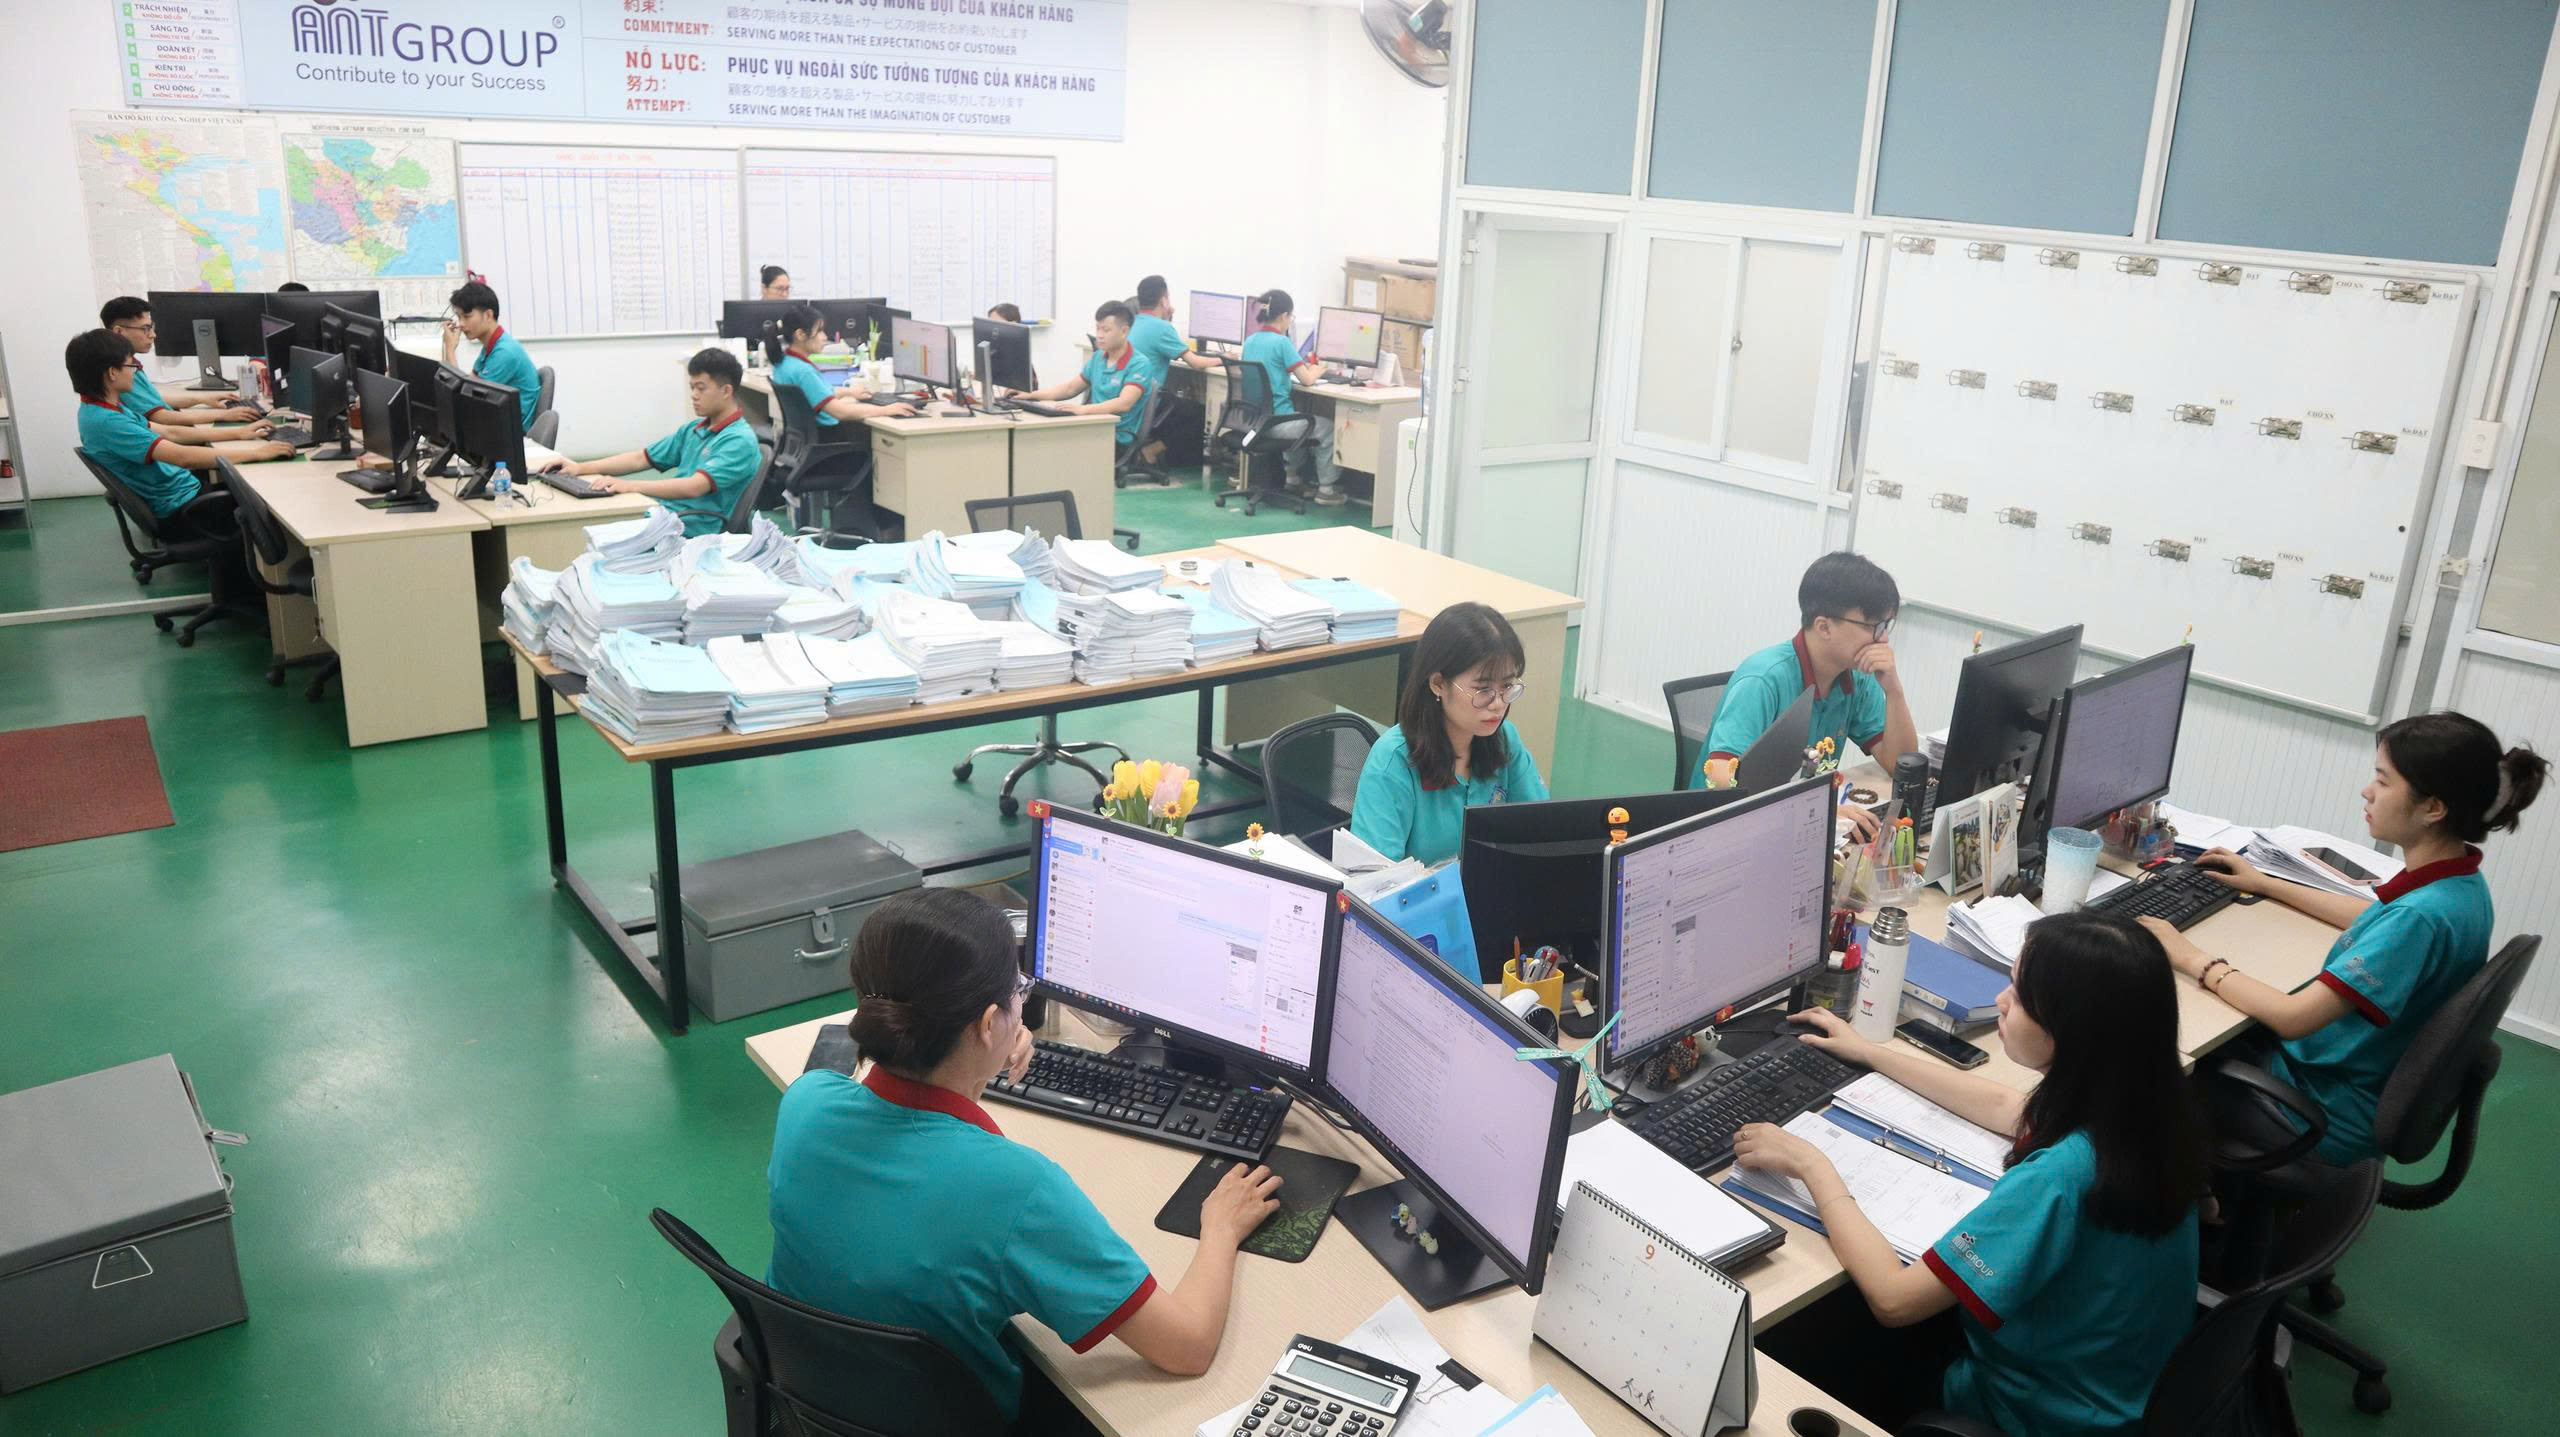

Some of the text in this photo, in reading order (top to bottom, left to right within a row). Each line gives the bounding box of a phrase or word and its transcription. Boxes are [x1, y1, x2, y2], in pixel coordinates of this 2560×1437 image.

[990, 2, 1033, 19] KHÁCH
[1039, 5, 1073, 22] HÀNG
[624, 18, 714, 35] COMMITMENT:
[727, 26, 1017, 55] SERVING MORE THAN THE EXPECTATIONS OF CUSTOMER
[296, 63, 546, 90] Contribute to your Success
[728, 57, 1095, 92] PHỤC VỤ NGOÀI SỨC TƯỞNG TƯỢNG CỦA KHÁCH HÀNG
[729, 104, 1011, 124] SERVING MORE THAN THE IMAGINATION OF CUSTOMER
[1154, 1026, 1171, 1038] DELL
[1645, 1244, 1655, 1260] 9
[1298, 1343, 1312, 1352] deli
[1264, 1392, 1276, 1400] OFF
[1254, 1406, 1266, 1414] AC
[1286, 1401, 1298, 1410] MC
[1247, 1417, 1254, 1425] C
[1345, 1421, 1355, 1429] M+
